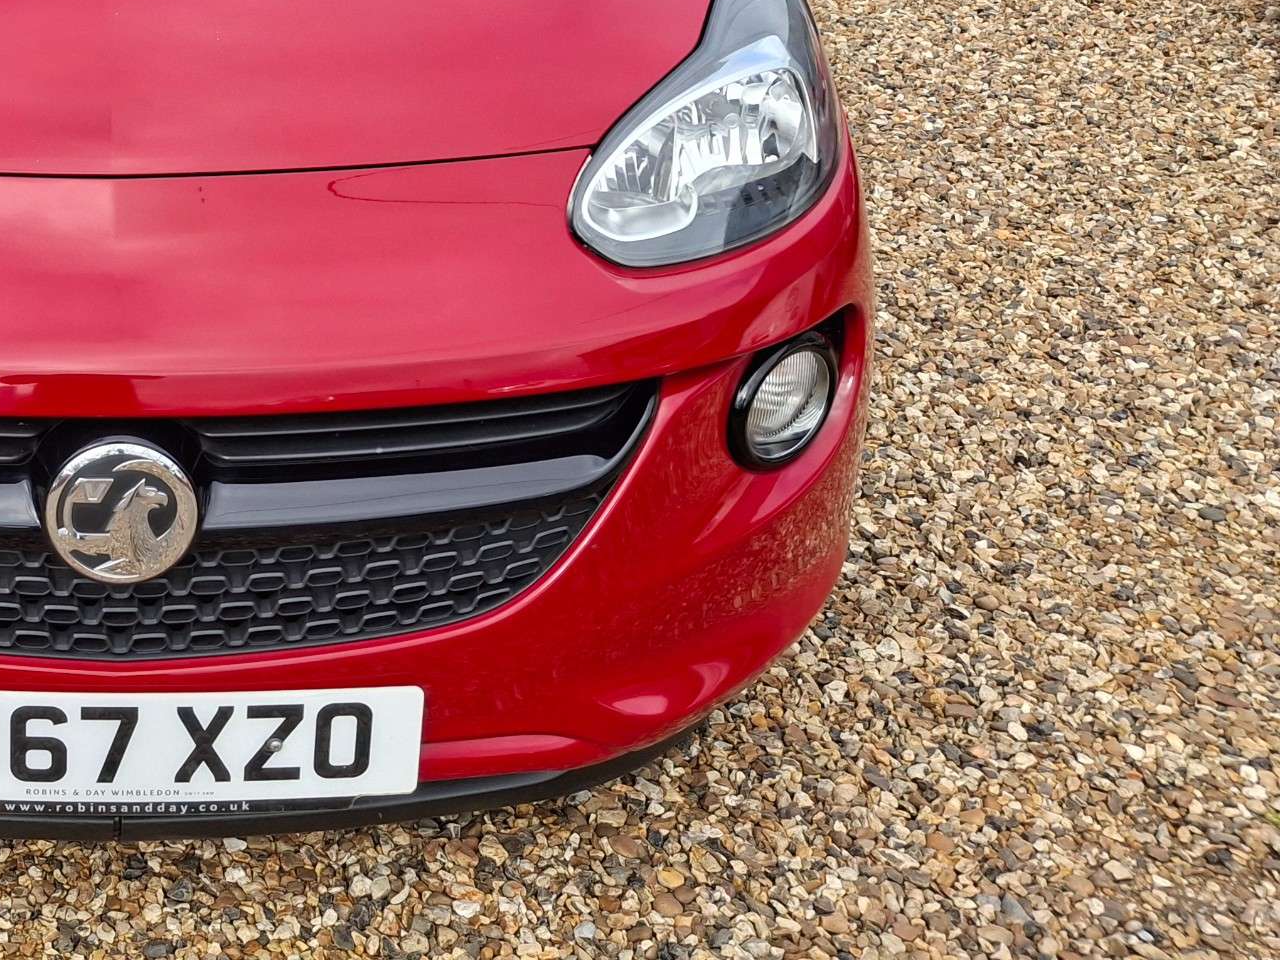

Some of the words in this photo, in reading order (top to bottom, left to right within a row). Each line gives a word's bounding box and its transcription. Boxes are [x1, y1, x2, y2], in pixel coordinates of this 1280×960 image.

[174, 701, 373, 783] XZO
[25, 788, 67, 796] ROBINS
[72, 788, 80, 796] &
[85, 788, 107, 796] DAY
[111, 788, 181, 796] WIMBLEDON
[4, 801, 250, 814] www.robinsandday.co.uk
